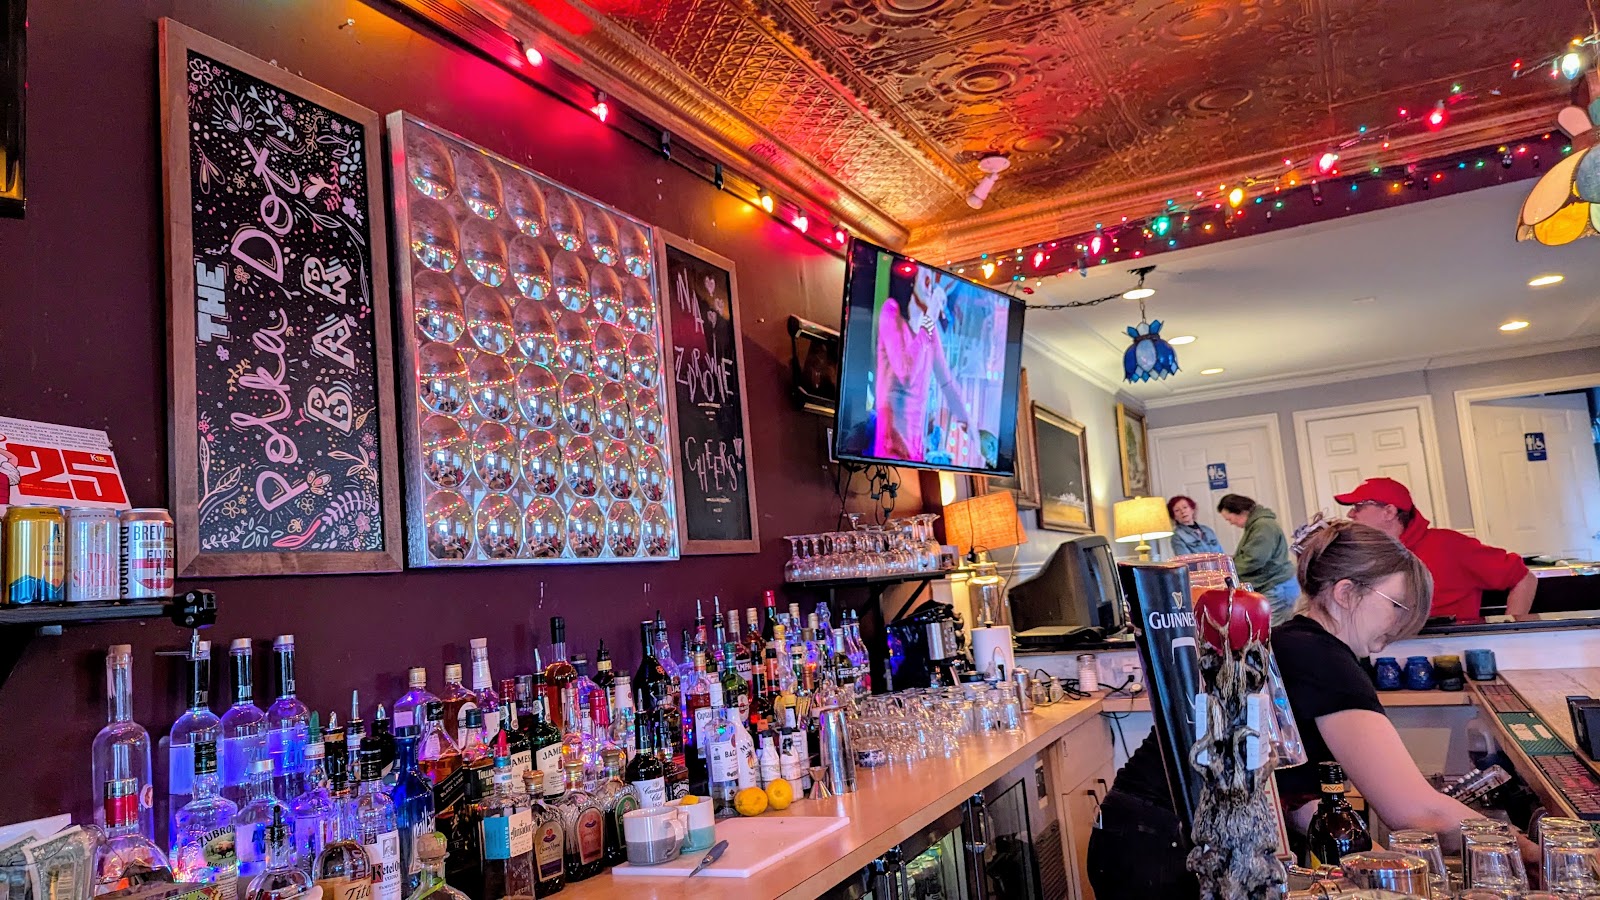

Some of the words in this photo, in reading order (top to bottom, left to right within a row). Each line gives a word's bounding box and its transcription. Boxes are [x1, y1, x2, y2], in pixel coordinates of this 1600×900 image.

[231, 138, 300, 283] Dot
[196, 262, 226, 342] THE
[676, 268, 705, 335] NA
[303, 256, 354, 433] BAR
[231, 309, 306, 512] Polka
[6, 442, 127, 504] 25
[1148, 611, 1196, 630] GUINNES
[511, 754, 532, 767] AMES
